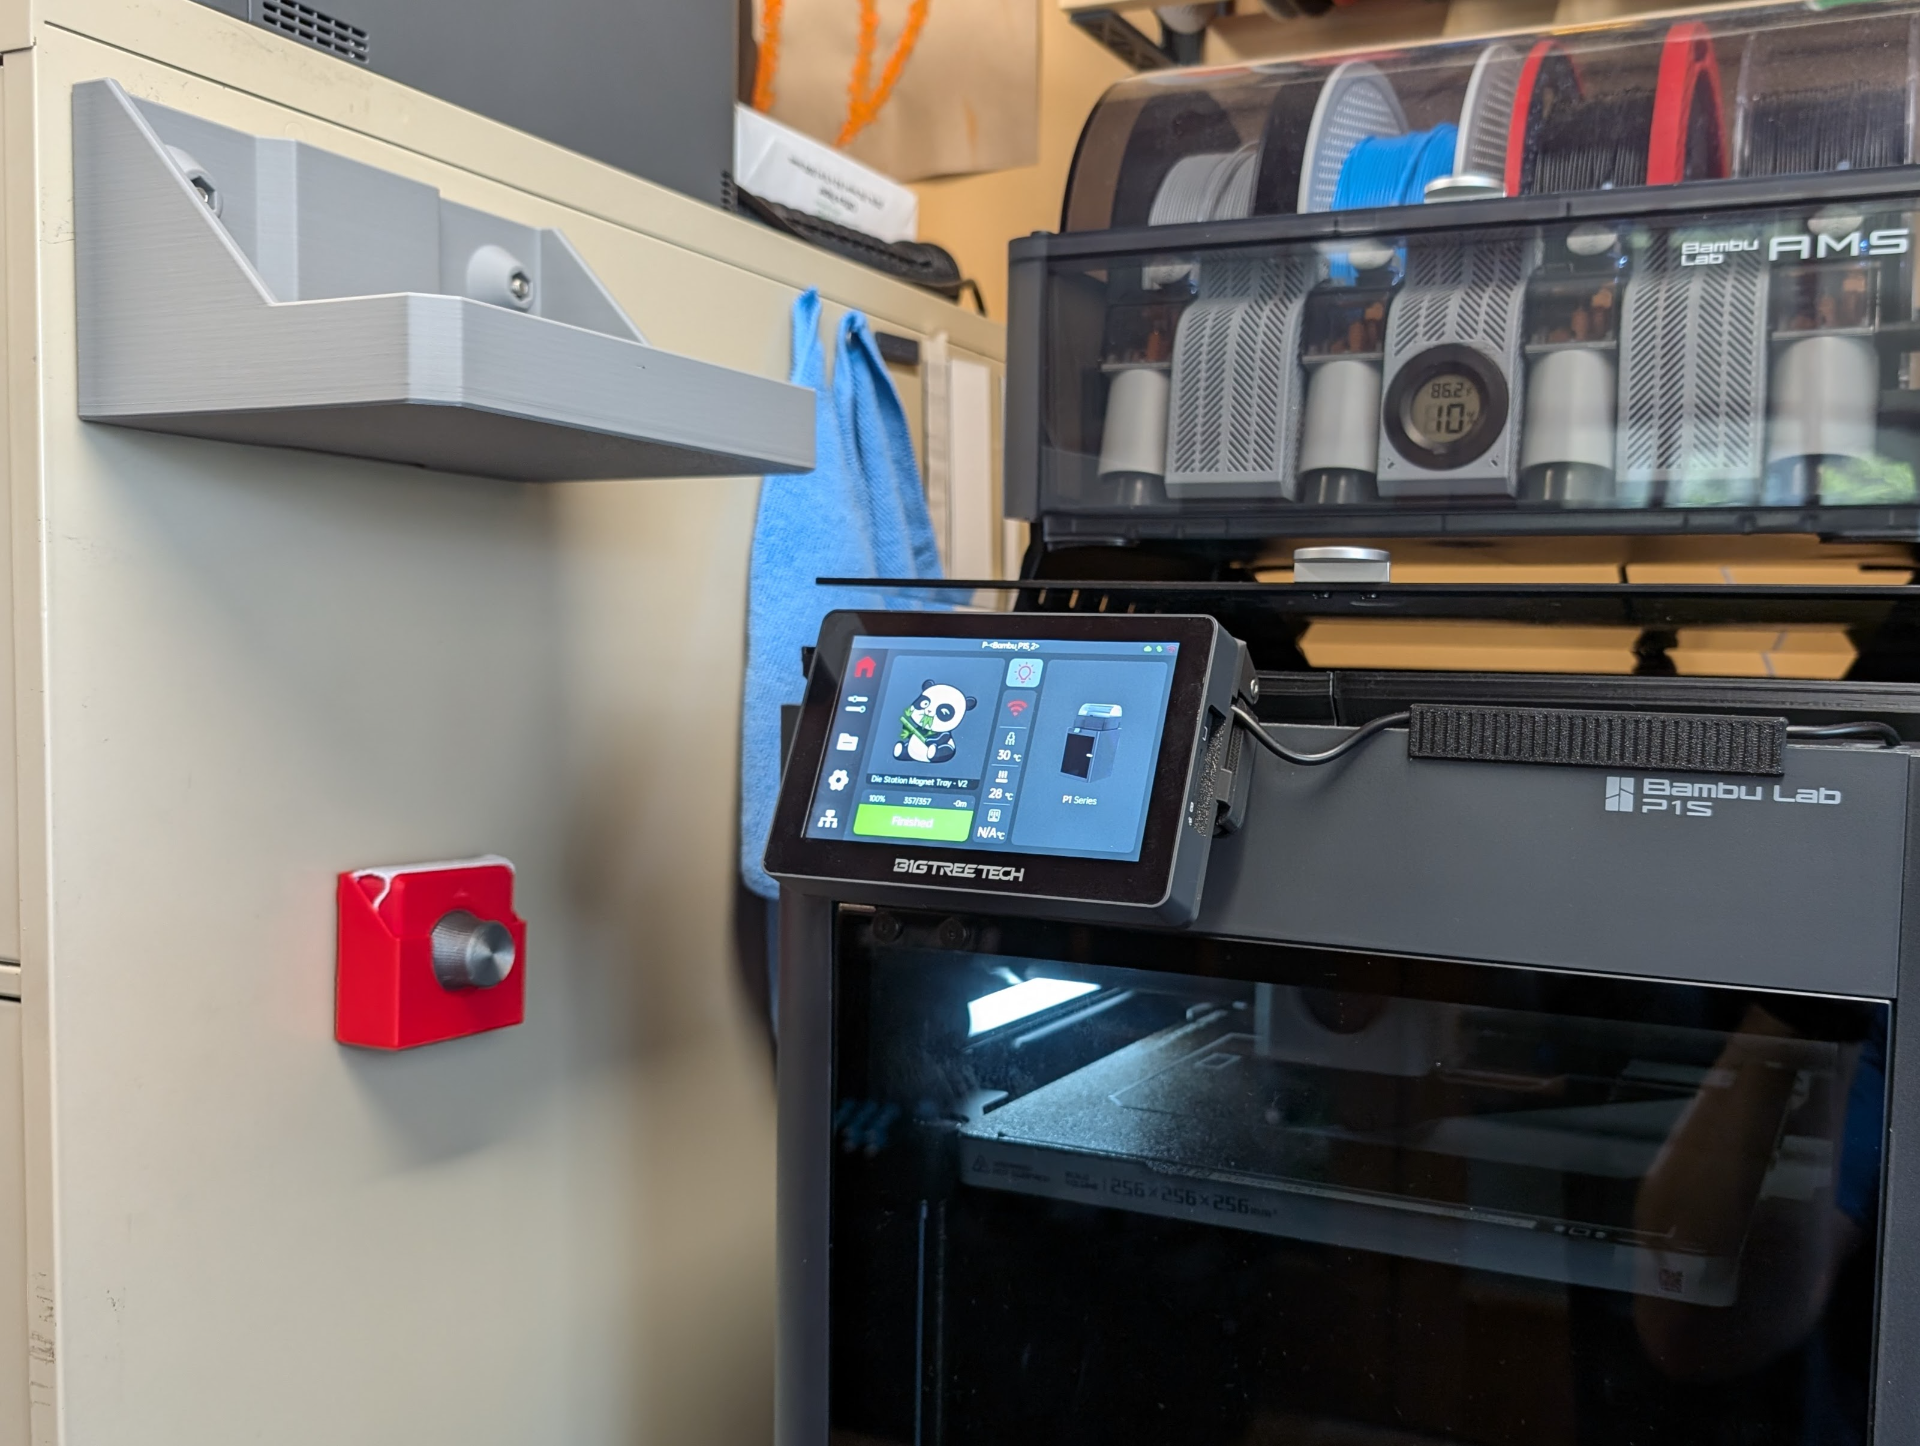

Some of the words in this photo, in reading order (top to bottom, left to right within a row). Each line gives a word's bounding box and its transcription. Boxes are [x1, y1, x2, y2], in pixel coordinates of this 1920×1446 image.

[1681, 238, 1759, 255] Bambu
[1768, 228, 1909, 261] AMS
[1681, 253, 1725, 266] Lab
[1436, 404, 1465, 434] 10
[996, 749, 1011, 761] 30
[870, 774, 883, 783] Die
[883, 775, 908, 785] Station
[908, 777, 935, 787] Magnet
[936, 778, 952, 789] Tray
[957, 780, 968, 788] V2
[987, 788, 1003, 799] 28
[1642, 778, 1762, 801] Bambu
[1773, 785, 1842, 805] Lab
[869, 794, 886, 803] 100%
[903, 796, 932, 806] 357/357
[1062, 795, 1072, 804] P1
[1073, 796, 1098, 806] Series
[1641, 798, 1713, 817] P1S
[891, 816, 935, 829] Finished
[1110, 1178, 1146, 1199] 256
